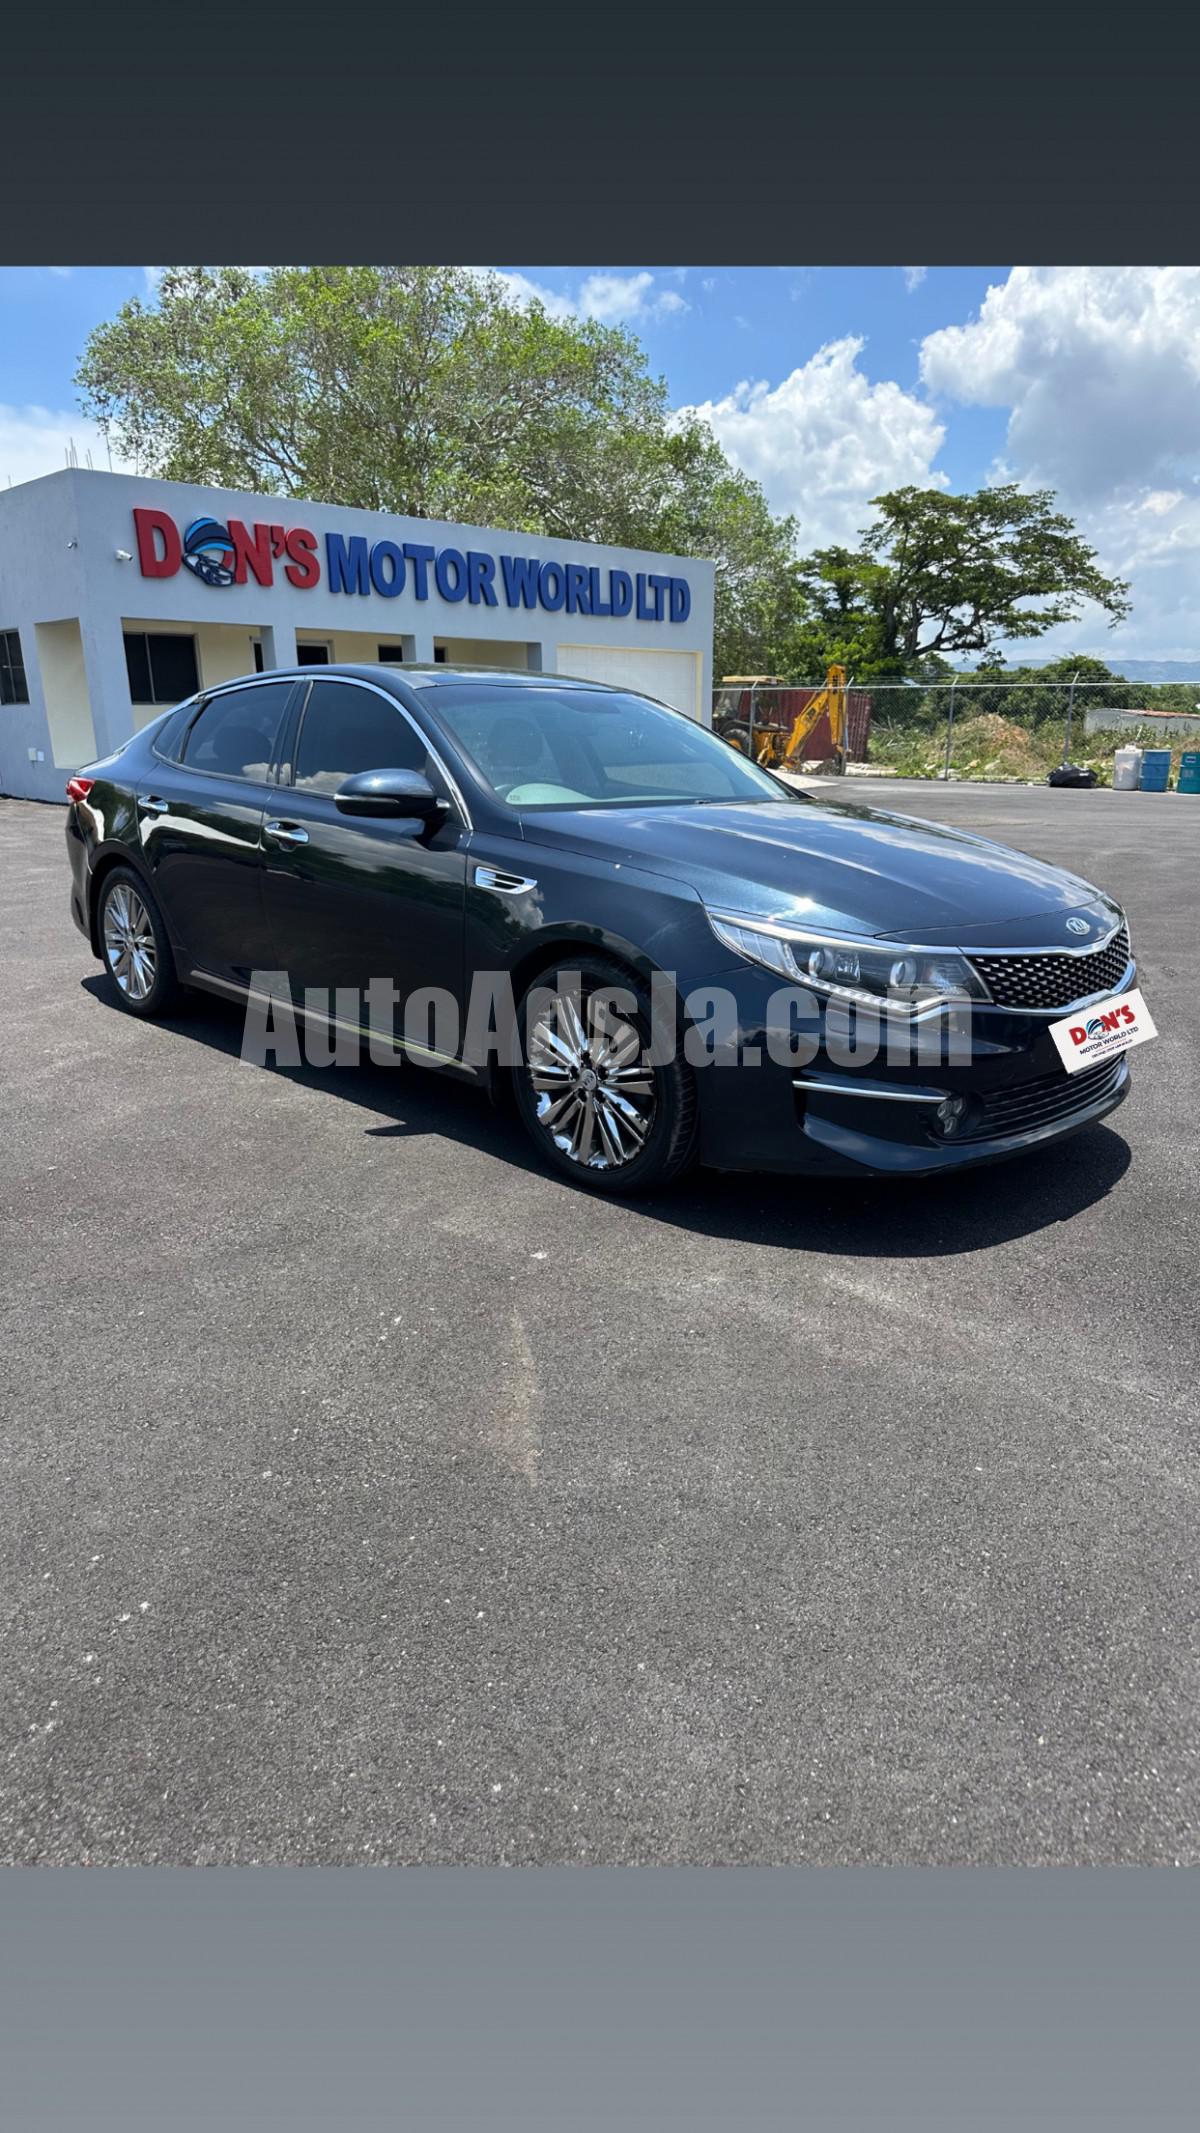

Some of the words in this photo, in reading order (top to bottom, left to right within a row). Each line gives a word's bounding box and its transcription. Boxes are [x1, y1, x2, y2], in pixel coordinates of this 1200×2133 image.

[134, 508, 320, 589] DON'S
[326, 532, 498, 606] MOTOR
[500, 555, 633, 617] WORLD
[636, 573, 691, 623] LTD
[1079, 1040, 1103, 1055] MOTOR
[1103, 1030, 1128, 1046] WORLD
[1126, 1026, 1139, 1037] LTD
